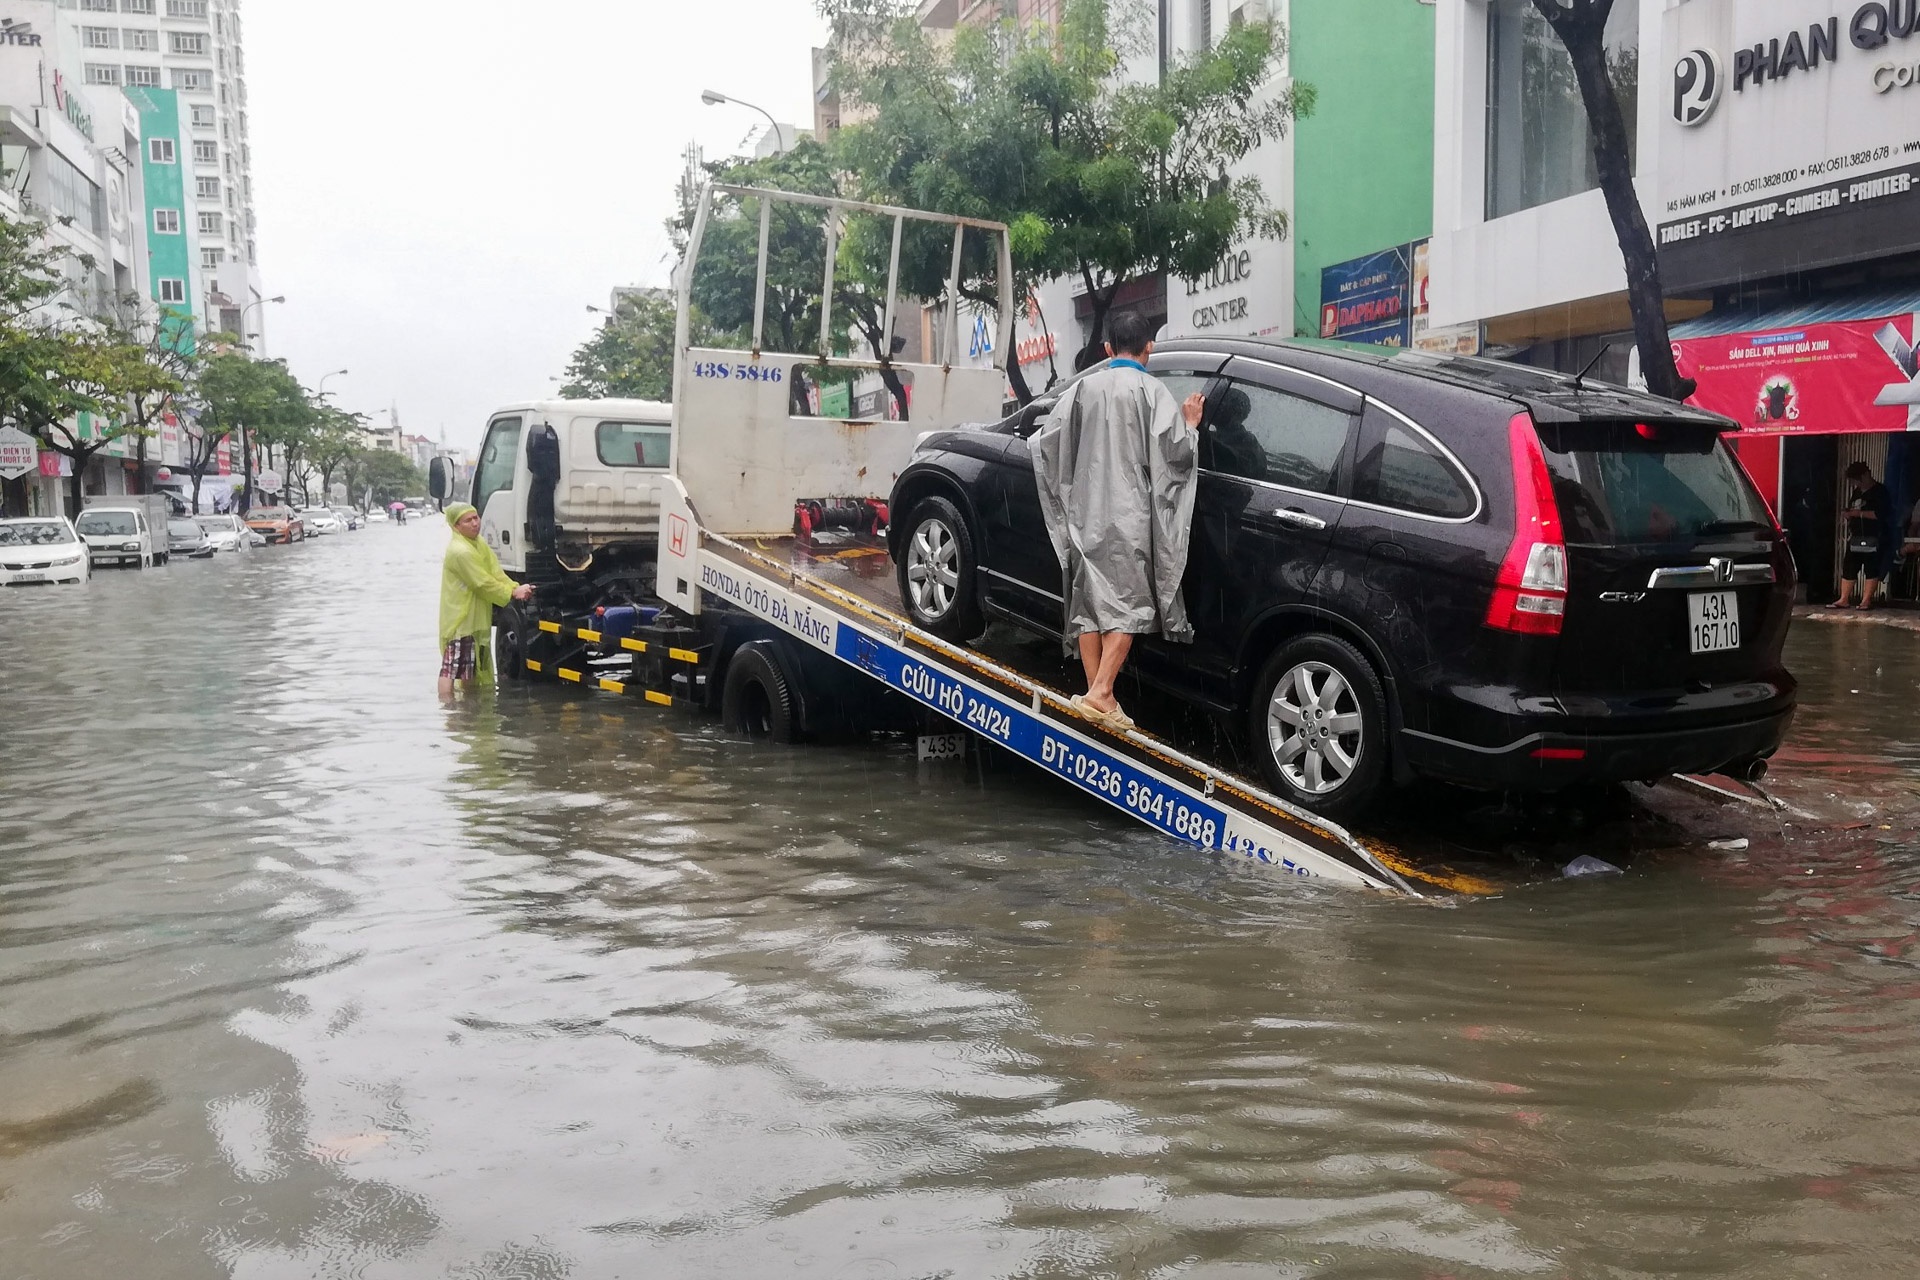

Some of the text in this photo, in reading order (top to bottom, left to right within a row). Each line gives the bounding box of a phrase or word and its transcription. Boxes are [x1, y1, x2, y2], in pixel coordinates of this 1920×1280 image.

[1733, 16, 1838, 93] PHAN
[1666, 201, 1679, 213] 145
[1698, 190, 1717, 204] NGHI
[1808, 163, 1827, 177] FAX:
[1873, 145, 1890, 161] 678
[1661, 172, 1911, 244] TABLET PC LAPTOP CAMERA PRINTER
[1192, 297, 1249, 329] CENTER
[1339, 295, 1400, 327] DAPHACO
[1745, 348, 1761, 358] DELL
[1777, 343, 1794, 355] RINH
[1811, 340, 1829, 351] XINH
[702, 564, 742, 600] HONDA
[771, 598, 790, 623] ĐÀ
[1599, 591, 1646, 603] CR-V
[1702, 594, 1728, 621] 43A
[1694, 621, 1738, 651] 167.10
[901, 663, 936, 700] CỨU
[939, 684, 964, 718] HỘ
[967, 698, 1011, 741] 24/24
[1126, 778, 1217, 851] 3641888
[928, 735, 956, 754] 43S
